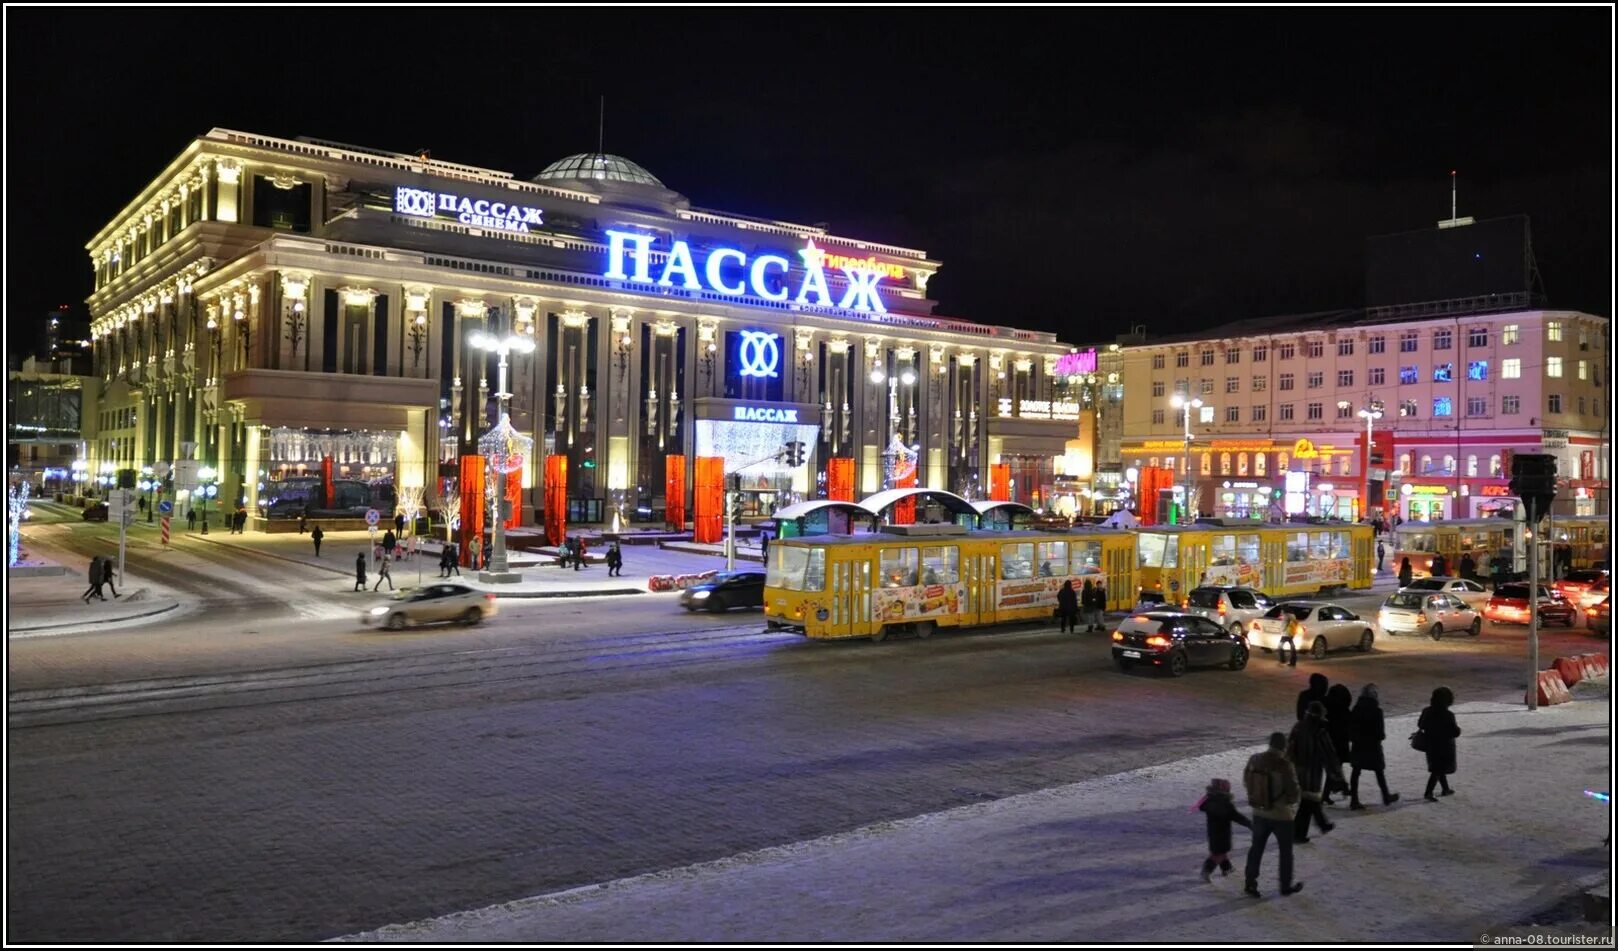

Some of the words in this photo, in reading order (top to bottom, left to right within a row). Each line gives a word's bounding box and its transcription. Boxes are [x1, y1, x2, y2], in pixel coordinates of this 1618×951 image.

[438, 193, 544, 225] ПАССАЖ
[458, 212, 530, 233] СИНЕМА
[603, 229, 888, 314] ПАССАЖ
[734, 406, 798, 423] ПАССАЖ
[1481, 485, 1510, 497] KFC
